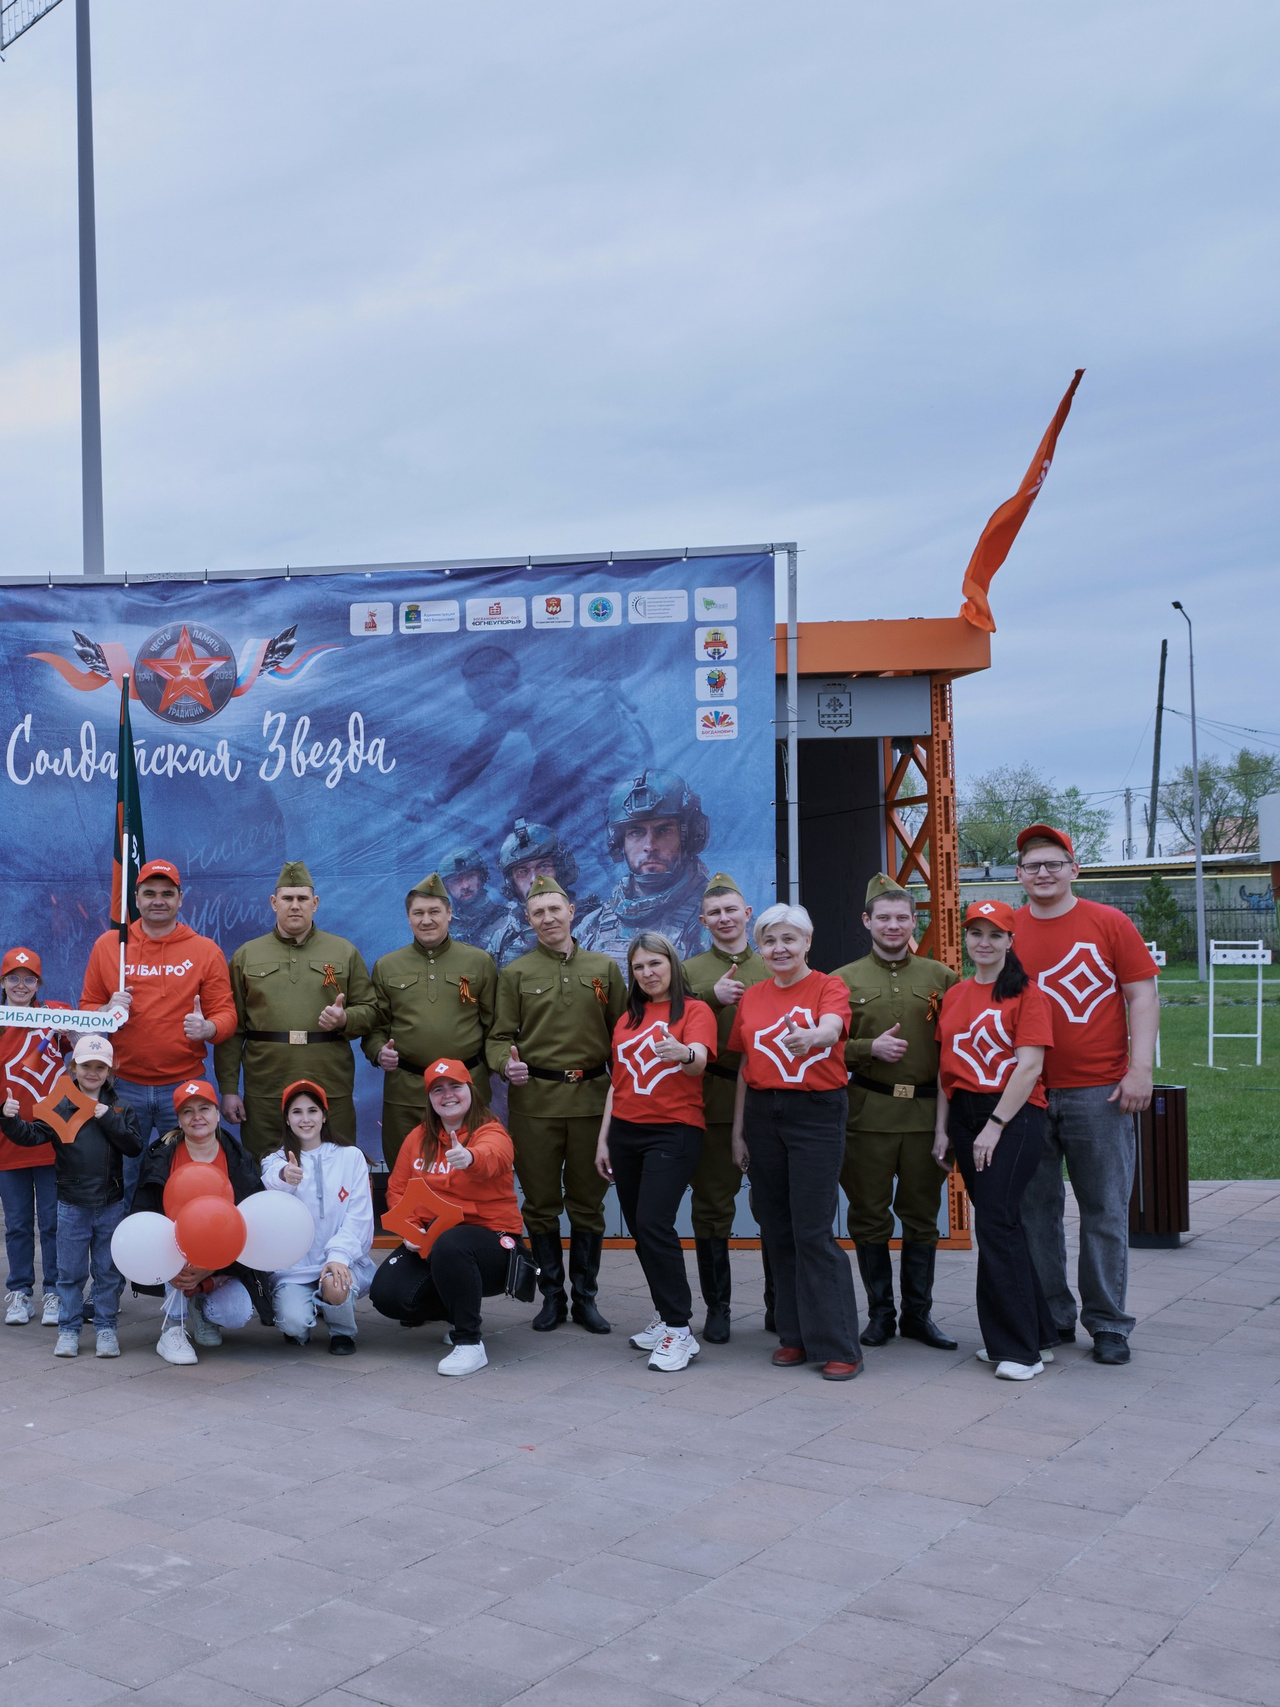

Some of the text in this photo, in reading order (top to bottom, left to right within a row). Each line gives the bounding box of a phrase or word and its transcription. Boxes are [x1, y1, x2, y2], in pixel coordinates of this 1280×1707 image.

[149, 632, 172, 653] ЧЕСТЬ
[192, 629, 221, 653] ПАМЯТЬ
[167, 706, 205, 719] ТРАДИЦИИ
[258, 710, 397, 789] Звезда
